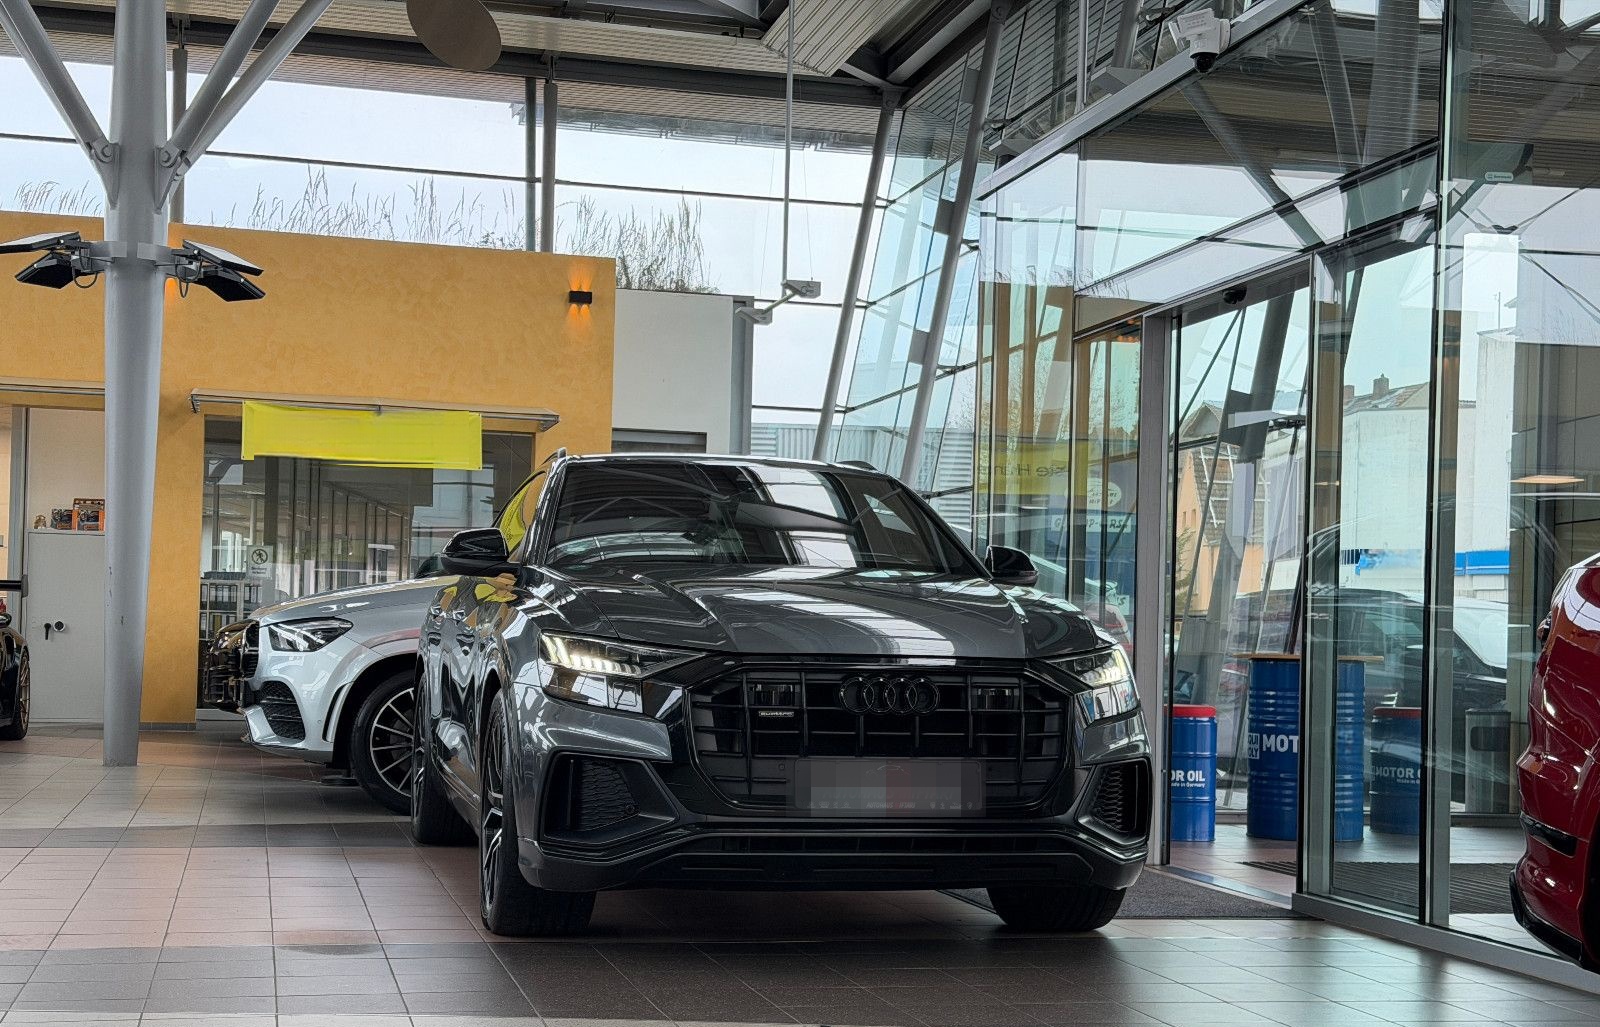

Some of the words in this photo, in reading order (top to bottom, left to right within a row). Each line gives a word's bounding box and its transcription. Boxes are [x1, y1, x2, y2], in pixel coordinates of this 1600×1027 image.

[1262, 733, 1299, 754] MOT
[1186, 770, 1206, 782] OIL
[1375, 766, 1415, 779] MOTOR
